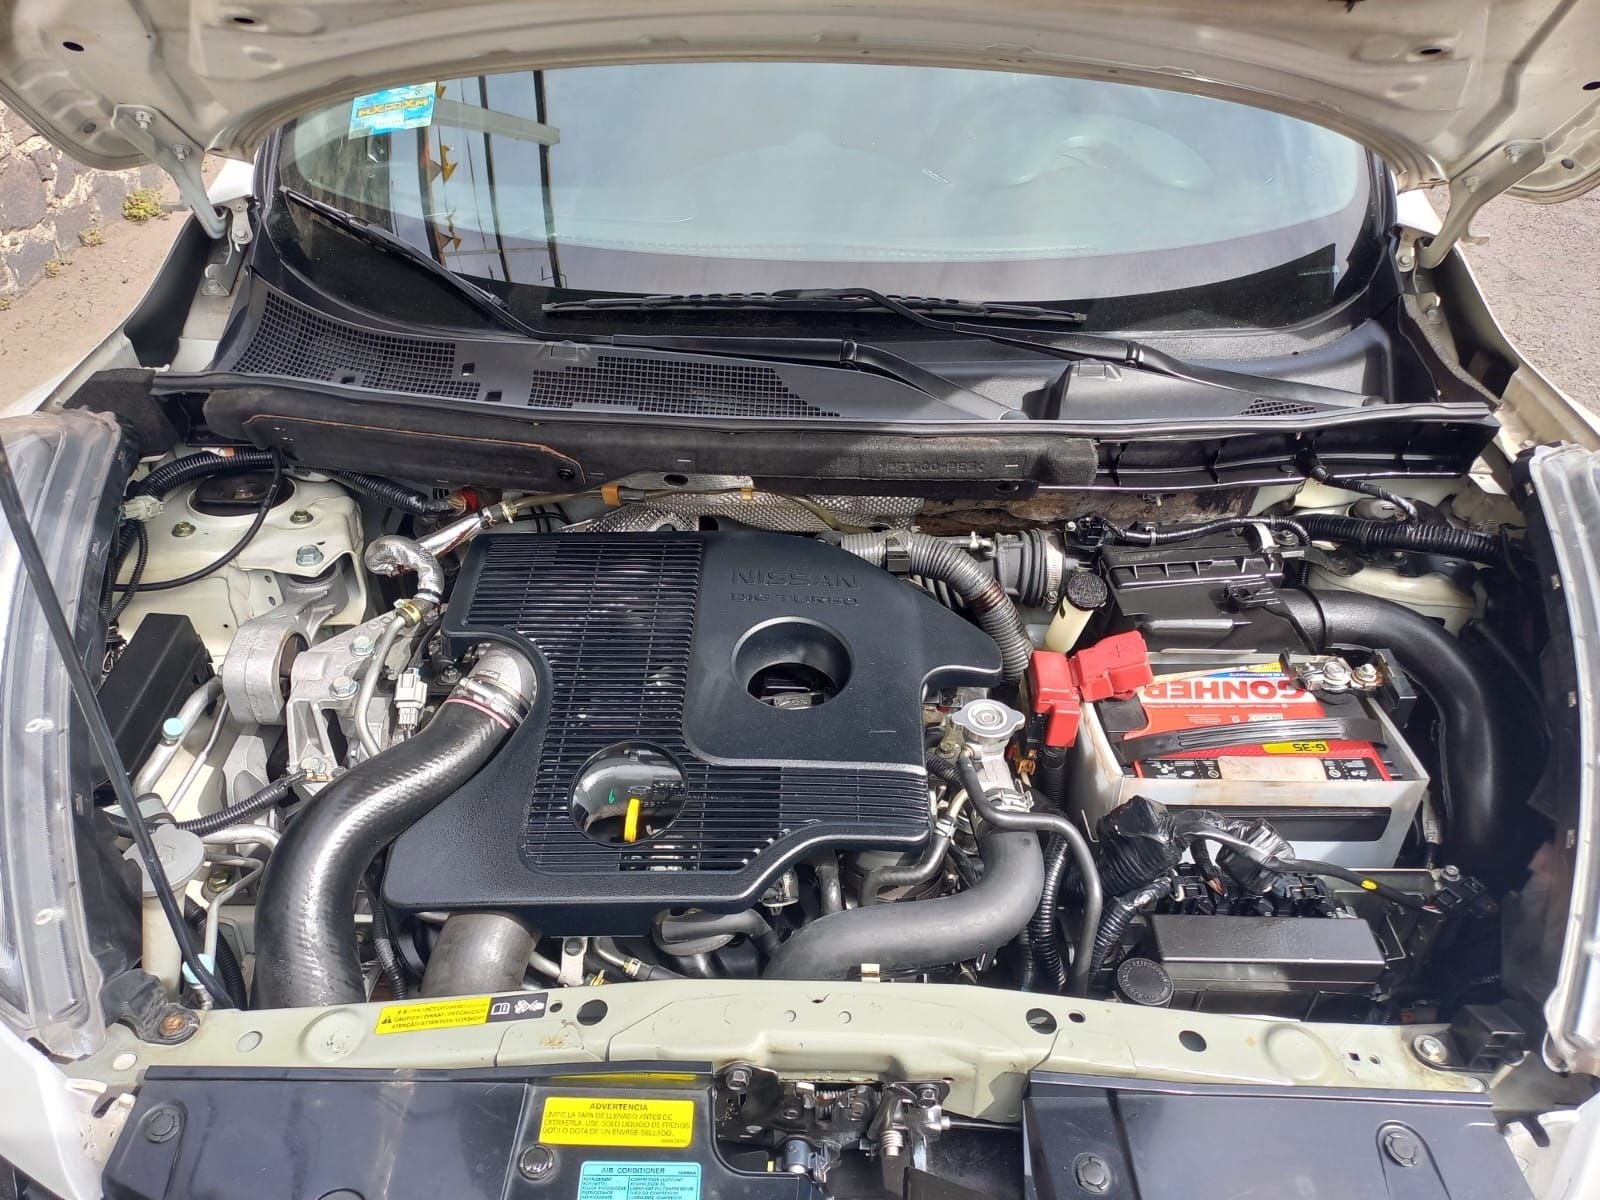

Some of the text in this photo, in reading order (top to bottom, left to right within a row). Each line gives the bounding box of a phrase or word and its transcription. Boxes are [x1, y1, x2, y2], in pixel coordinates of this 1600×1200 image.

[731, 567, 860, 589] NISSAN
[775, 593, 859, 606] TURBO
[1145, 680, 1305, 699] GONHER
[1292, 743, 1327, 751] G-35
[590, 1103, 648, 1111] ADVERTENCIA
